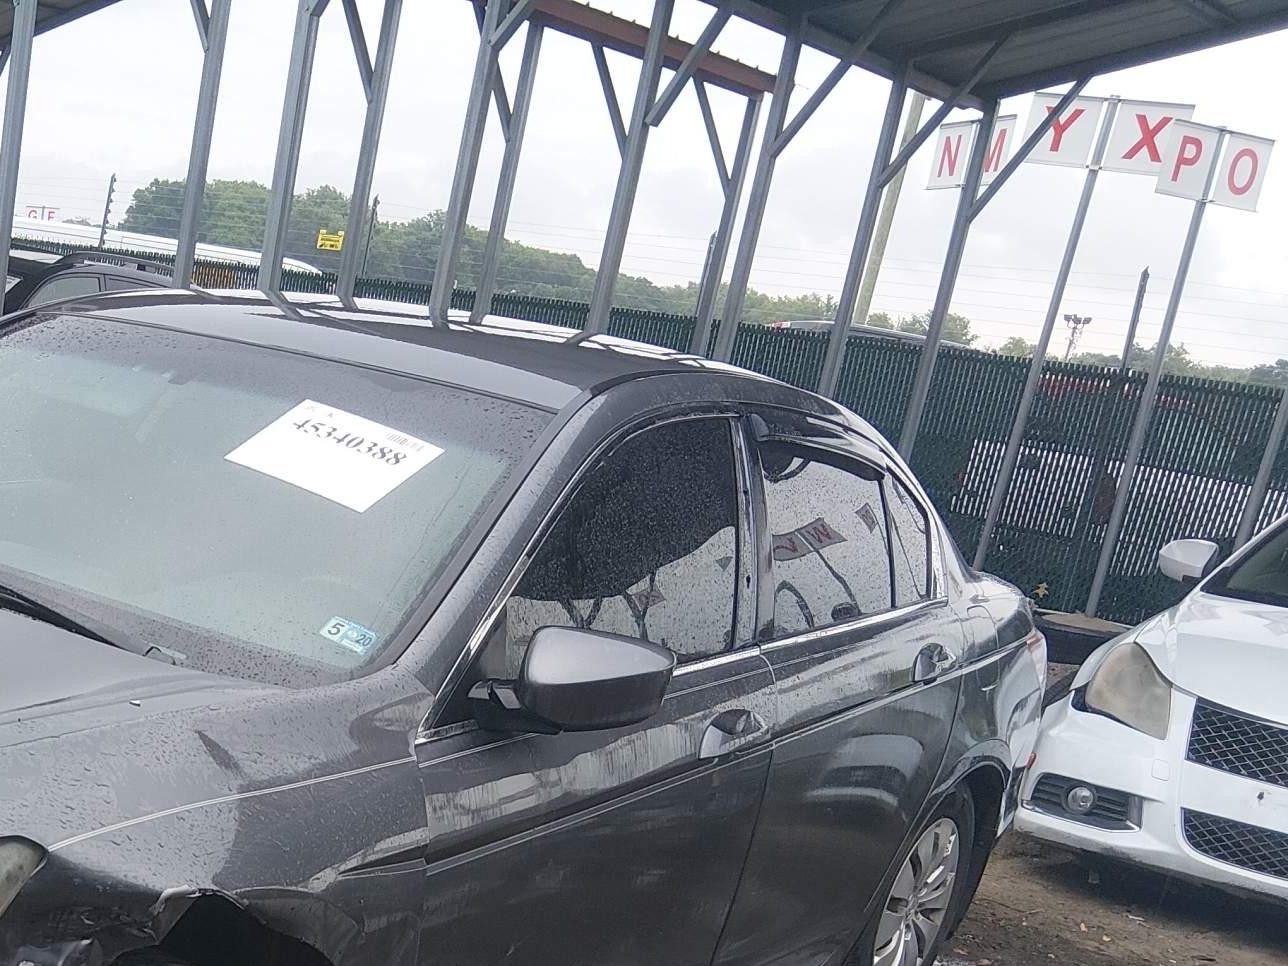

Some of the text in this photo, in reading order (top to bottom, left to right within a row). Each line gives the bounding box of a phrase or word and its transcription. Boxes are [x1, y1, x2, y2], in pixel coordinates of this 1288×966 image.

[936, 134, 962, 177] N
[1046, 105, 1086, 152] Y
[1122, 114, 1173, 163] X
[1171, 135, 1203, 182] P
[1227, 148, 1259, 196] O
[292, 418, 407, 465] 45340388
[327, 622, 345, 636] 5
